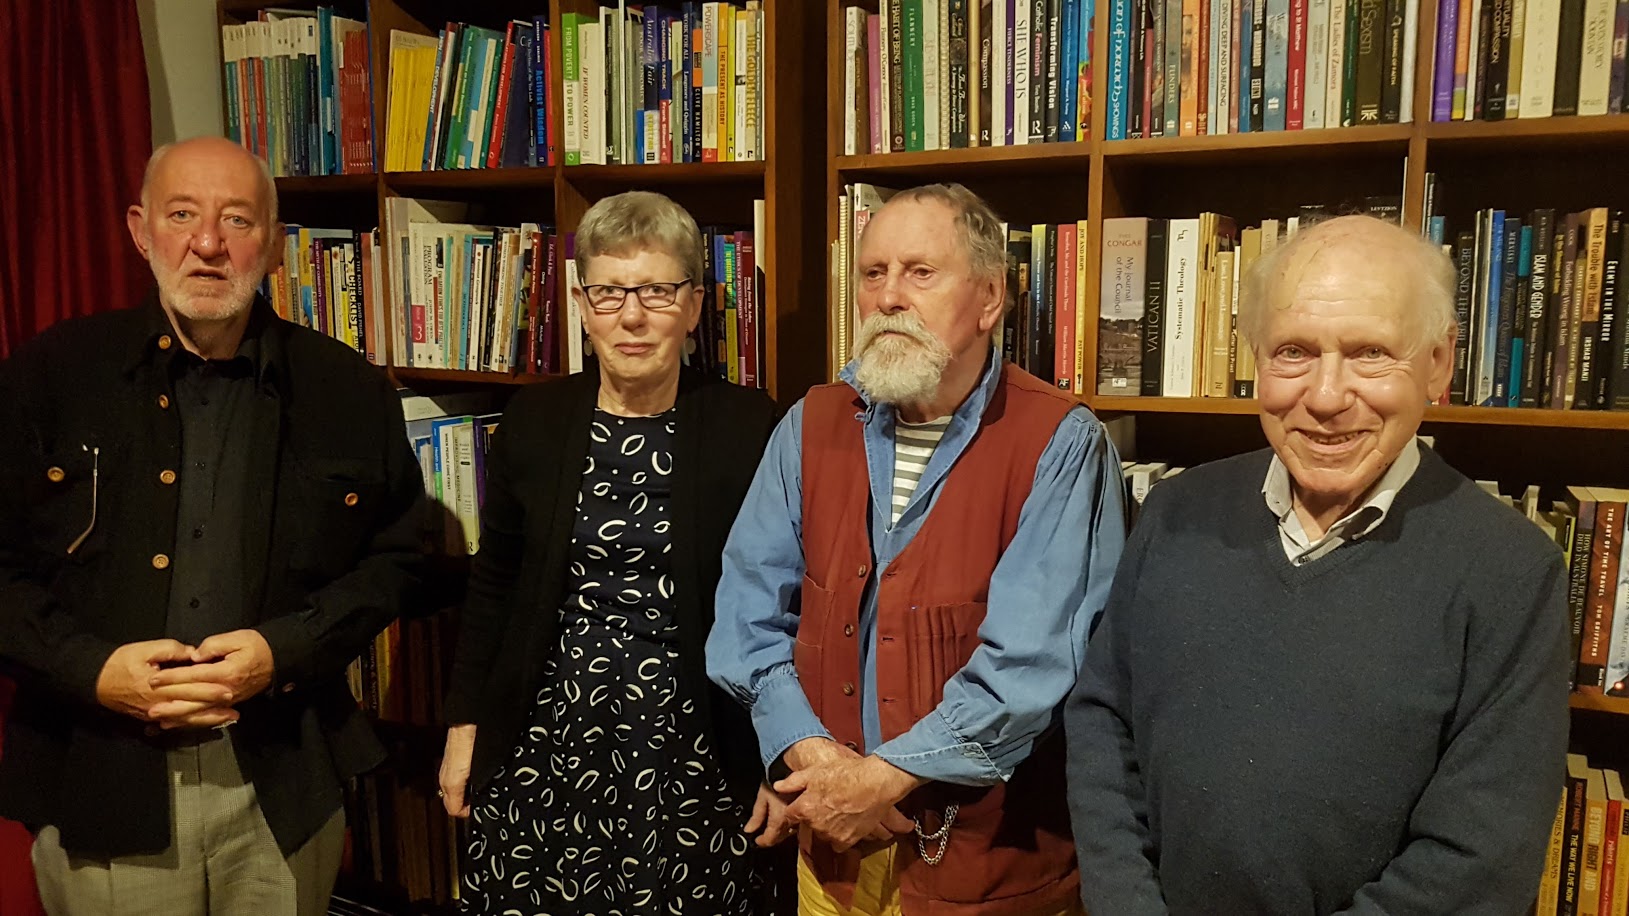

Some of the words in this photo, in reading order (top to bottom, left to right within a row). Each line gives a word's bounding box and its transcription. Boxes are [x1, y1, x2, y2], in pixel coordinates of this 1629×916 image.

[892, 6, 900, 29] HABIT
[1035, 0, 1043, 31] Catholic
[1333, 5, 1342, 19] The
[747, 35, 756, 51] THE
[893, 30, 900, 40] OF
[1016, 20, 1027, 44] SHE
[1332, 22, 1341, 46] Ladies
[1359, 9, 1377, 54] Sexism
[1034, 33, 1042, 76] Feminism
[1048, 16, 1058, 77] Transforming
[1332, 48, 1340, 56] of
[583, 67, 588, 76] IF
[981, 39, 989, 88] Compassion
[1016, 48, 1026, 83] WHO
[1392, 58, 1397, 66] OF
[747, 55, 756, 93] GOLDEN
[1330, 59, 1339, 90] Zamora
[567, 84, 572, 94] TO
[1016, 88, 1026, 99] IS
[1048, 80, 1056, 108] Vision
[747, 97, 756, 128] FLEECE
[1592, 224, 1604, 239] The
[1115, 256, 1123, 265] of
[1125, 257, 1134, 270] My
[1533, 254, 1547, 273] ISLAM
[1590, 241, 1602, 272] Trouble
[737, 270, 742, 279] OF
[1115, 267, 1123, 281] the
[1176, 258, 1187, 294] Theology
[1459, 248, 1472, 293] BEYOND
[1562, 260, 1573, 295] Forbidding
[1588, 273, 1600, 290] with
[1606, 260, 1618, 285] ENEMY
[1124, 272, 1133, 301] Journal
[1149, 281, 1161, 290] II
[1532, 275, 1544, 290] AND
[1604, 287, 1615, 295] IN
[349, 275, 357, 327] CHECKLIST
[1114, 283, 1123, 313] Council
[1457, 296, 1470, 318] THE
[1529, 292, 1544, 318] GENDER
[1559, 296, 1571, 319] Wrong
[1587, 292, 1599, 315] Islam
[1603, 298, 1613, 312] THE
[1147, 296, 1159, 352] VATICAN
[1175, 298, 1183, 340] Systematic
[1601, 313, 1613, 342] MIRROR
[1456, 321, 1468, 344] VEIL
[1559, 328, 1568, 346] Islam
[1583, 336, 1592, 360] IRSHAD
[1580, 362, 1590, 382] MANJI
[1576, 533, 1584, 552] DIED
[1583, 533, 1591, 551] HOW
[1604, 541, 1610, 549] OF
[1575, 554, 1582, 562] IN
[1579, 554, 1589, 583] SIMONE
[1601, 552, 1609, 569] TIME
[1569, 563, 1581, 604] AUSTRALIA
[1578, 586, 1586, 596] DE
[1598, 571, 1607, 597] TRAVEL
[1573, 598, 1585, 635] BEAUVOIR
[1591, 621, 1601, 657] GRIFFITHS
[1575, 782, 1583, 807] ROBERT
[1589, 807, 1602, 844] BEYOND
[1550, 848, 1559, 879] DREAMS
[1569, 848, 1577, 861] WAY
[1586, 844, 1599, 870] RIGHT
[1568, 861, 1576, 872] WE
[1567, 872, 1575, 886] LIVE
[1584, 870, 1597, 891] AND
[1565, 887, 1574, 903] NOW
